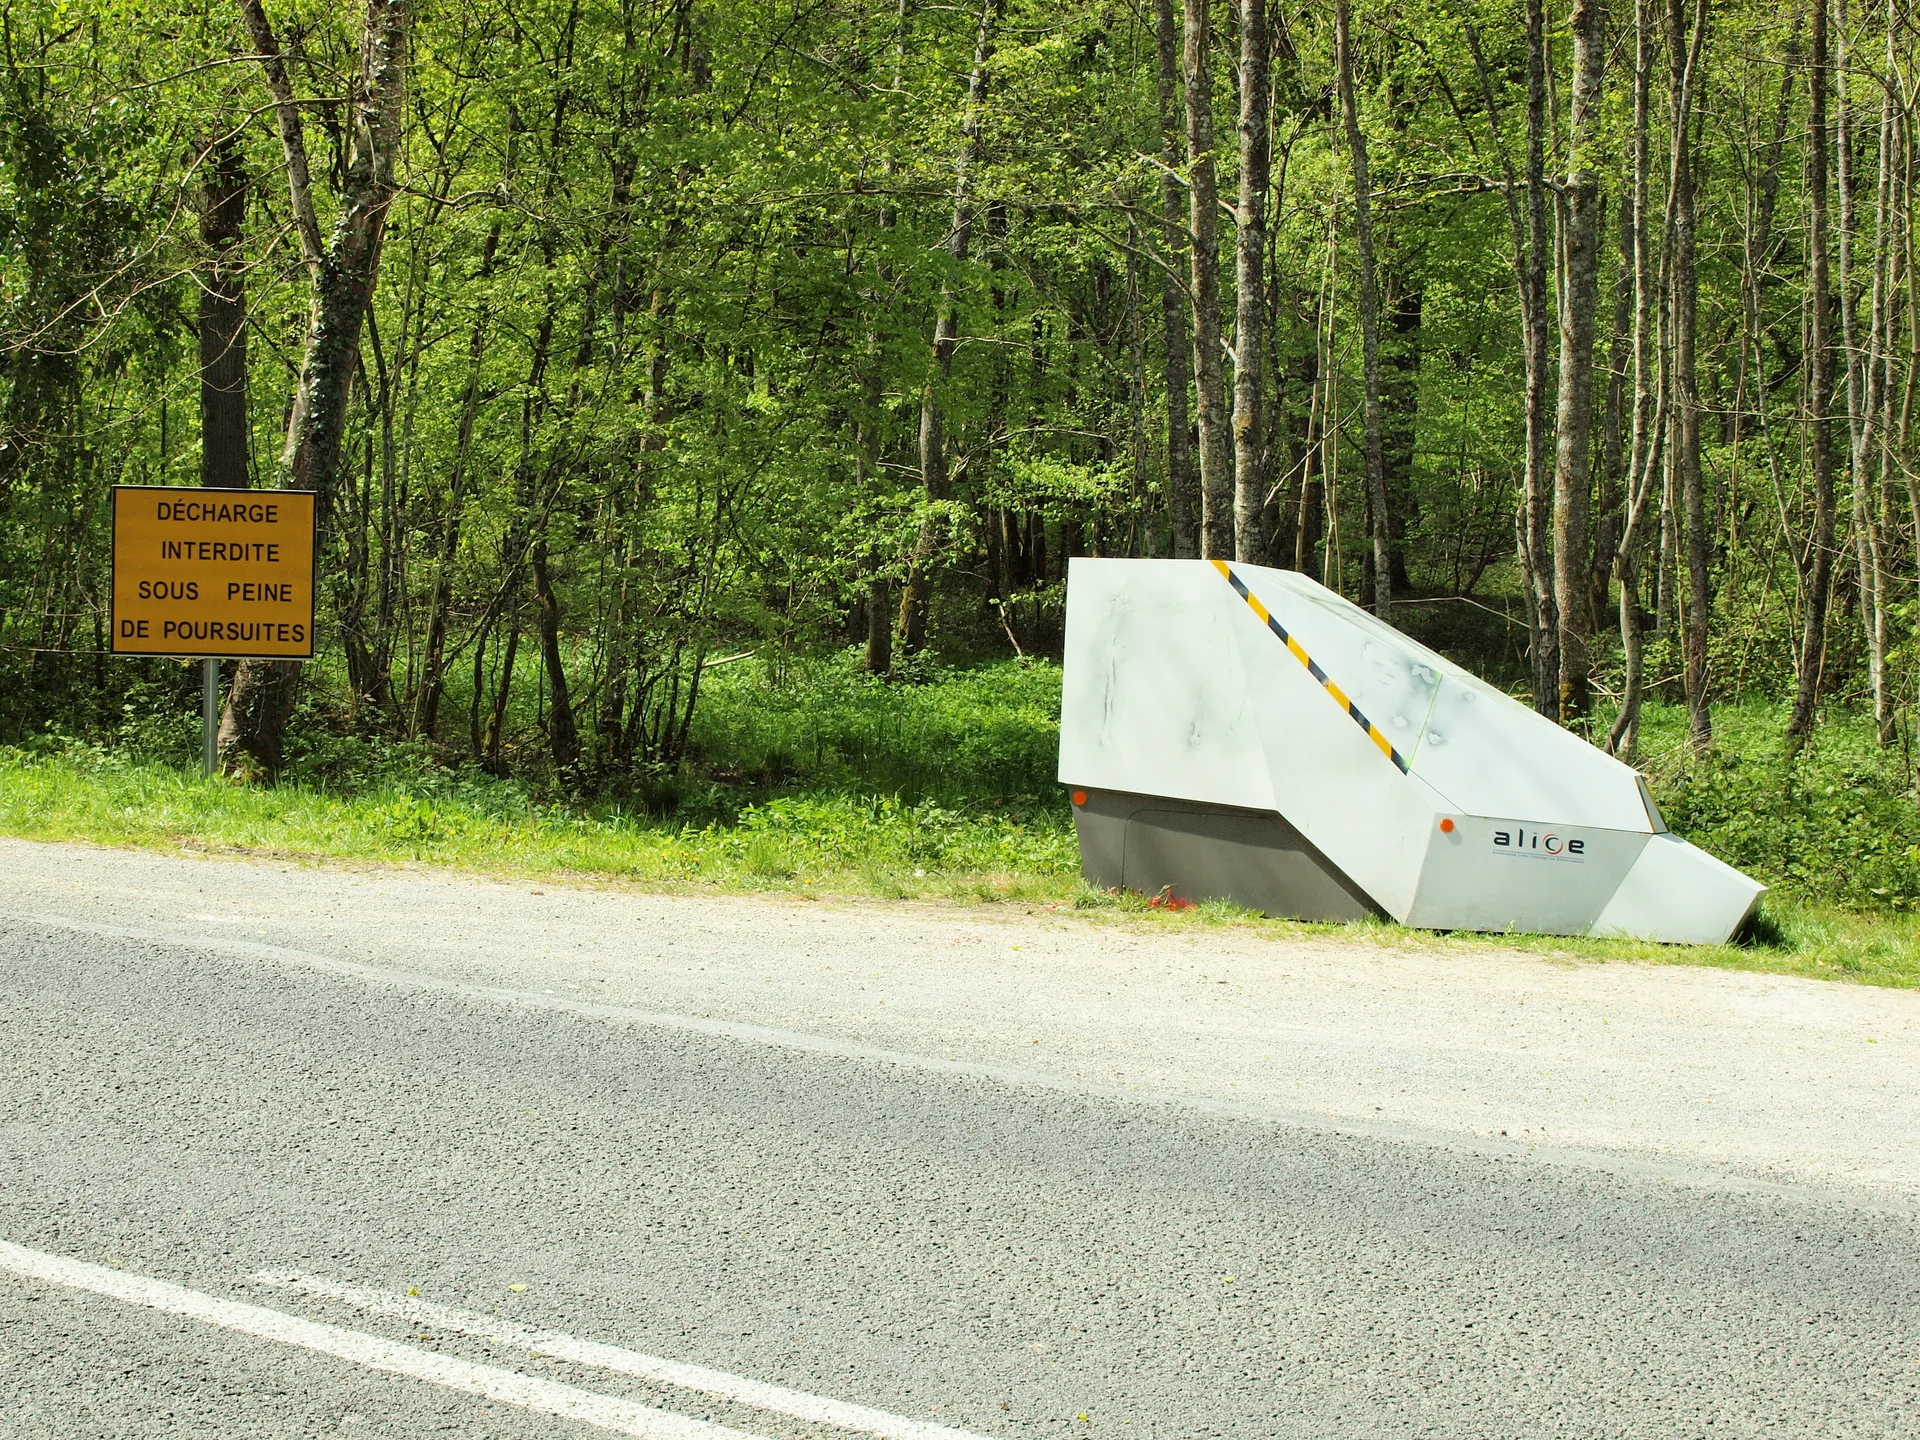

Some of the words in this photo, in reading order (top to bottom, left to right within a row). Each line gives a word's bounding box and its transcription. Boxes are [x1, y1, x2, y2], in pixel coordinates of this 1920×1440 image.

[157, 498, 278, 523] DÉCHARGE
[161, 541, 280, 562] INTERDITE
[138, 581, 199, 600] SOUS
[227, 583, 293, 602] PEINE
[120, 620, 150, 638] DE
[163, 621, 305, 642] POURSUITES
[1493, 829, 1585, 854] alice
